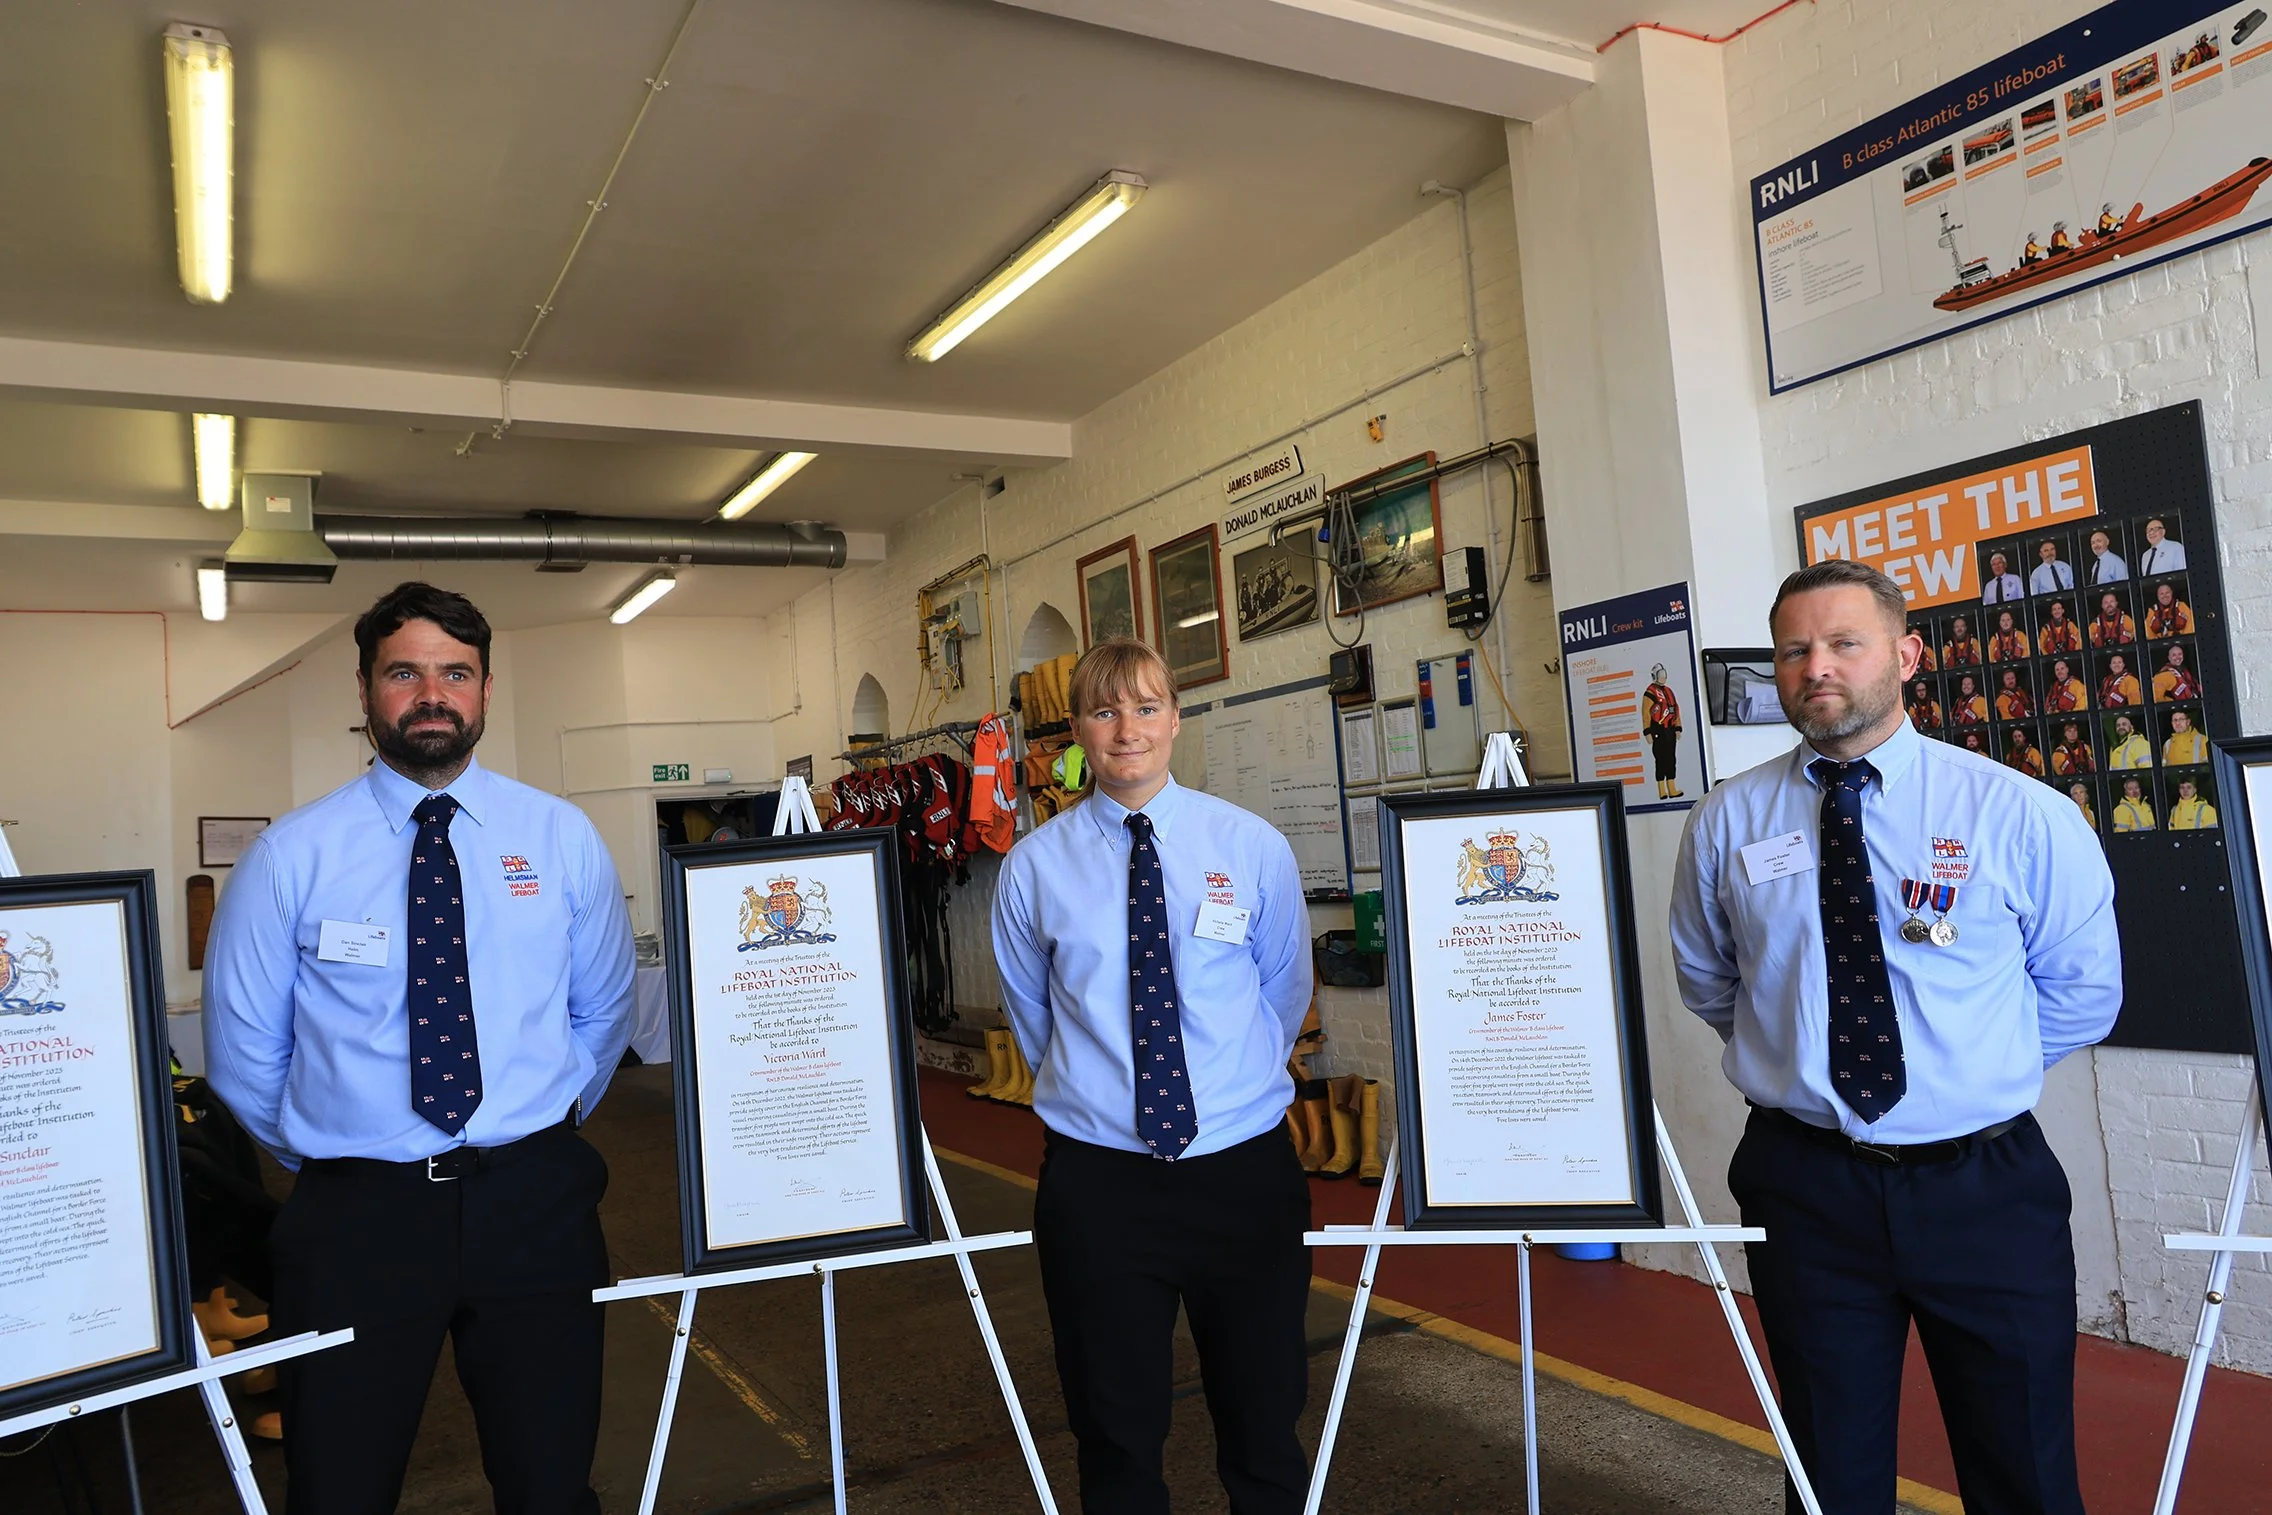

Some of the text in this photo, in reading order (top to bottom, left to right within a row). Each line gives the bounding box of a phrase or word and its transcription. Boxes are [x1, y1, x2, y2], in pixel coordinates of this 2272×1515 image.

[1842, 52, 2066, 170] B class Atlantic 85 lifeboat
[1760, 160, 1819, 208] RNLI
[1766, 218, 1795, 237] B CLASS
[1767, 219, 1814, 246] ATLANTIC 85
[1769, 231, 1819, 257] inshore lifeboat
[1227, 457, 1290, 494] JAMES BURGESS
[1226, 484, 1317, 534] DONALD MCLAUCHLAN
[1811, 458, 2084, 561] MEET THE
[1884, 544, 1966, 598] EW
[1654, 611, 1686, 625] Lifeboats
[1563, 615, 1607, 644] RNLI
[1612, 619, 1644, 634] Crew kit
[1932, 862, 1968, 871] WALMER
[1933, 871, 1968, 879] LIFEBOAT
[1452, 920, 1566, 936] ROYAL NATIONAL
[1439, 931, 1582, 948] LIFEBOAT INSTITUTION
[1500, 948, 1511, 958] day
[1476, 958, 1502, 966] following
[734, 962, 843, 981] ROYAL NATIONAL
[721, 971, 858, 994] LIFEBOAT INSTITUTION
[1471, 975, 1556, 988] That the Thanks of the
[1448, 986, 1582, 1002] Royal National Lifeboat Institution
[1489, 999, 1497, 1008] be
[1499, 998, 1530, 1007] accorded
[753, 1013, 834, 1030] That the Thanks of the
[1484, 1011, 1546, 1025] James Foster
[34, 1025, 44, 1036] of
[729, 1024, 858, 1046] Royal National Lifeboat Institution
[770, 1040, 778, 1049] be
[779, 1036, 810, 1048] accorded
[764, 1048, 826, 1064] Victoria Ward
[8, 1070, 44, 1080] November
[32, 1077, 61, 1087] ordered
[14, 1094, 21, 1102] of
[38, 1085, 82, 1096] Institution
[0, 1101, 62, 1118] anks of the
[38, 1111, 95, 1126] Institution
[0, 1146, 52, 1163] Sinclair
[36, 1185, 50, 1194] and
